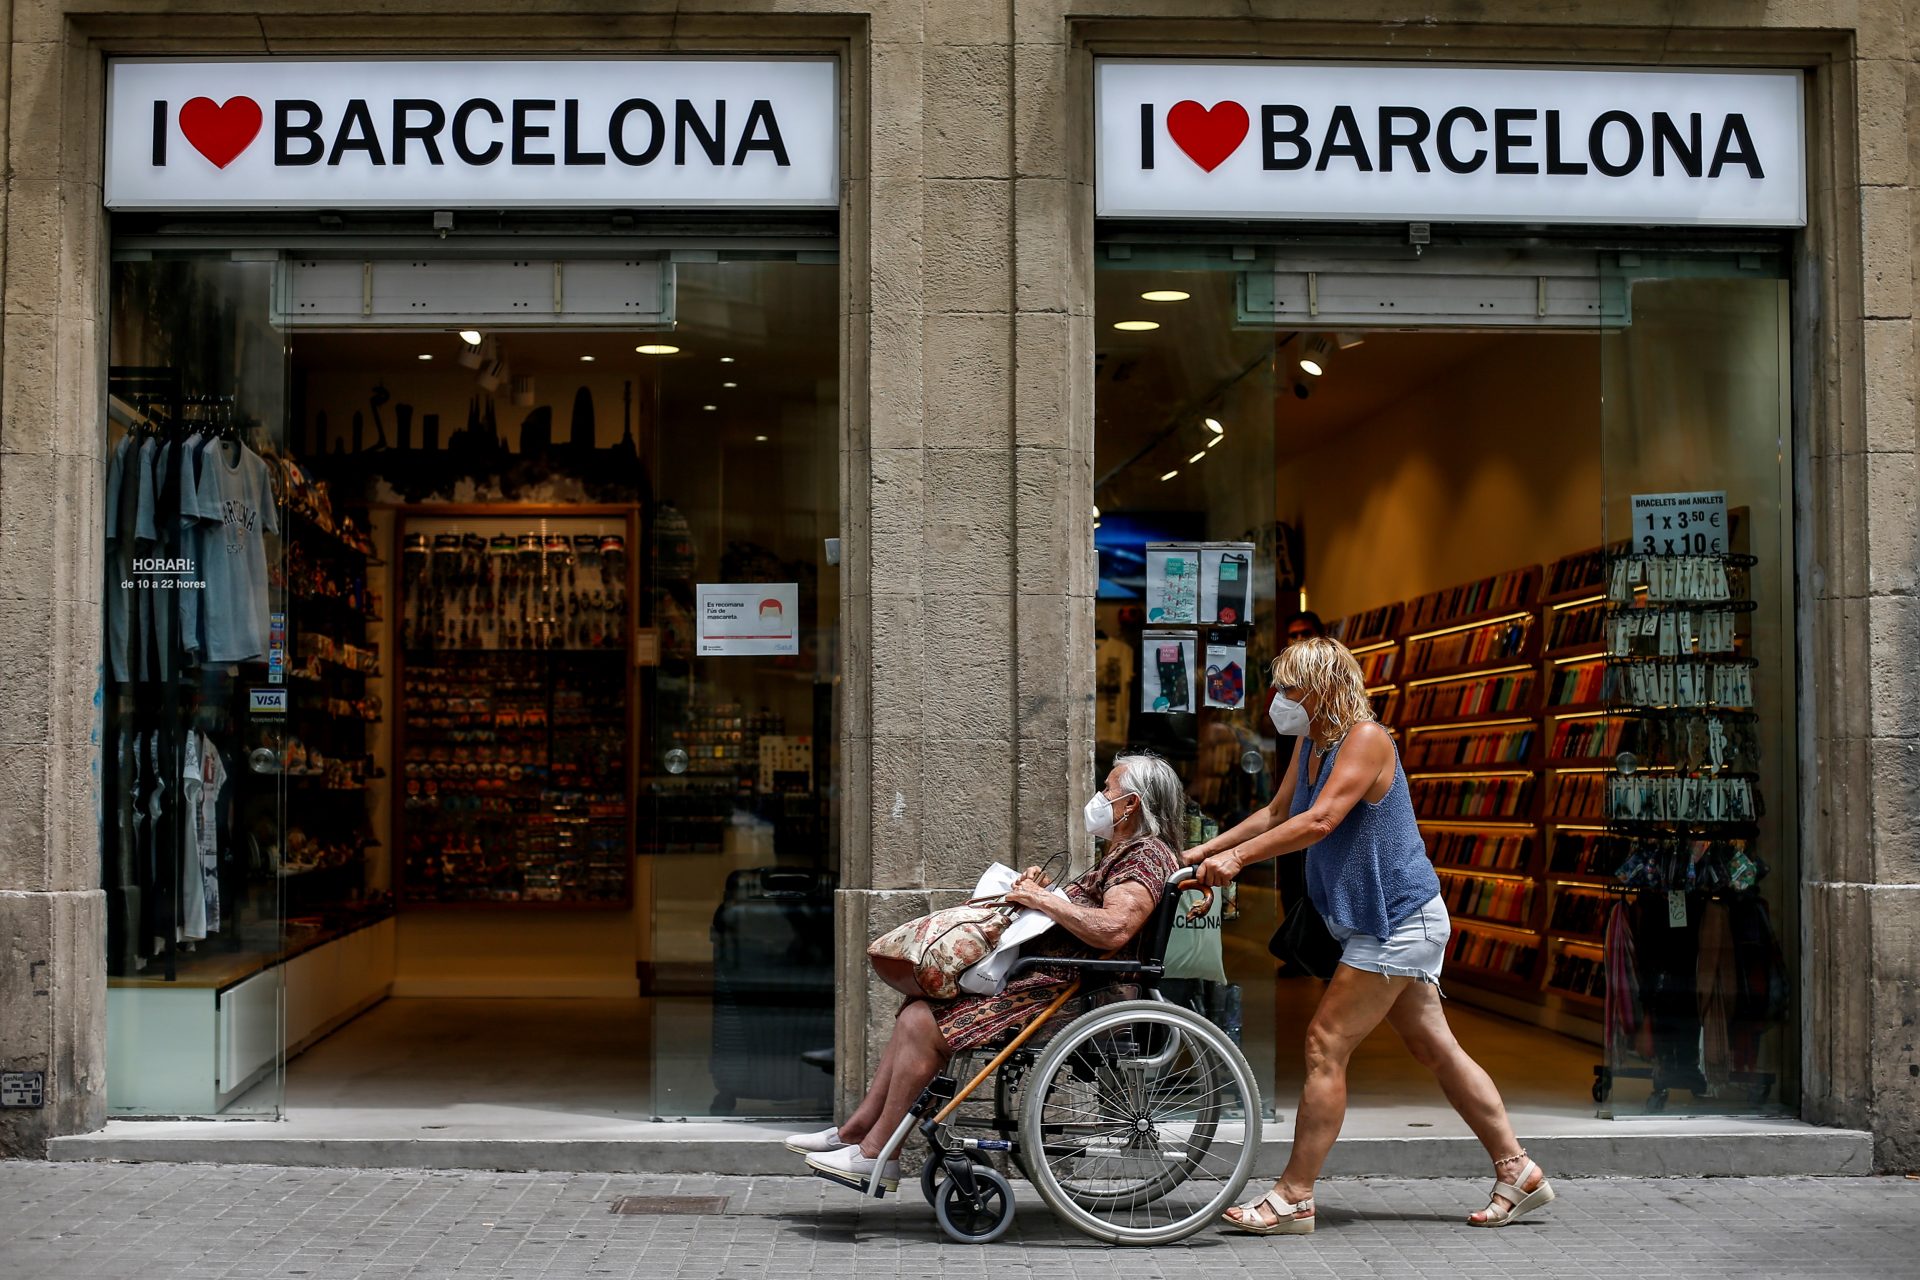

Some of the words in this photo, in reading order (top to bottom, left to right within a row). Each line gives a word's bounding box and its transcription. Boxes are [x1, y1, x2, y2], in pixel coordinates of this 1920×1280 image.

[153, 101, 167, 166] I
[274, 98, 791, 167] BARCELONA
[1141, 104, 1154, 170] I
[1261, 105, 1765, 179] BARCELONA
[1636, 498, 1676, 507] BRACELETS
[1679, 497, 1690, 505] and
[1693, 496, 1723, 504] ANKLETS
[1646, 513, 1654, 530] 1
[1663, 516, 1672, 529] x
[1710, 512, 1720, 527] €
[1643, 535, 1656, 555] 3
[1664, 539, 1675, 555] x
[1681, 533, 1706, 555] 10
[1711, 538, 1720, 552] €
[133, 558, 195, 571] HORARI:
[121, 579, 134, 588] de
[137, 579, 149, 588] 10
[161, 579, 173, 588] 22
[177, 579, 206, 588] hores
[256, 696, 281, 706] VISA
